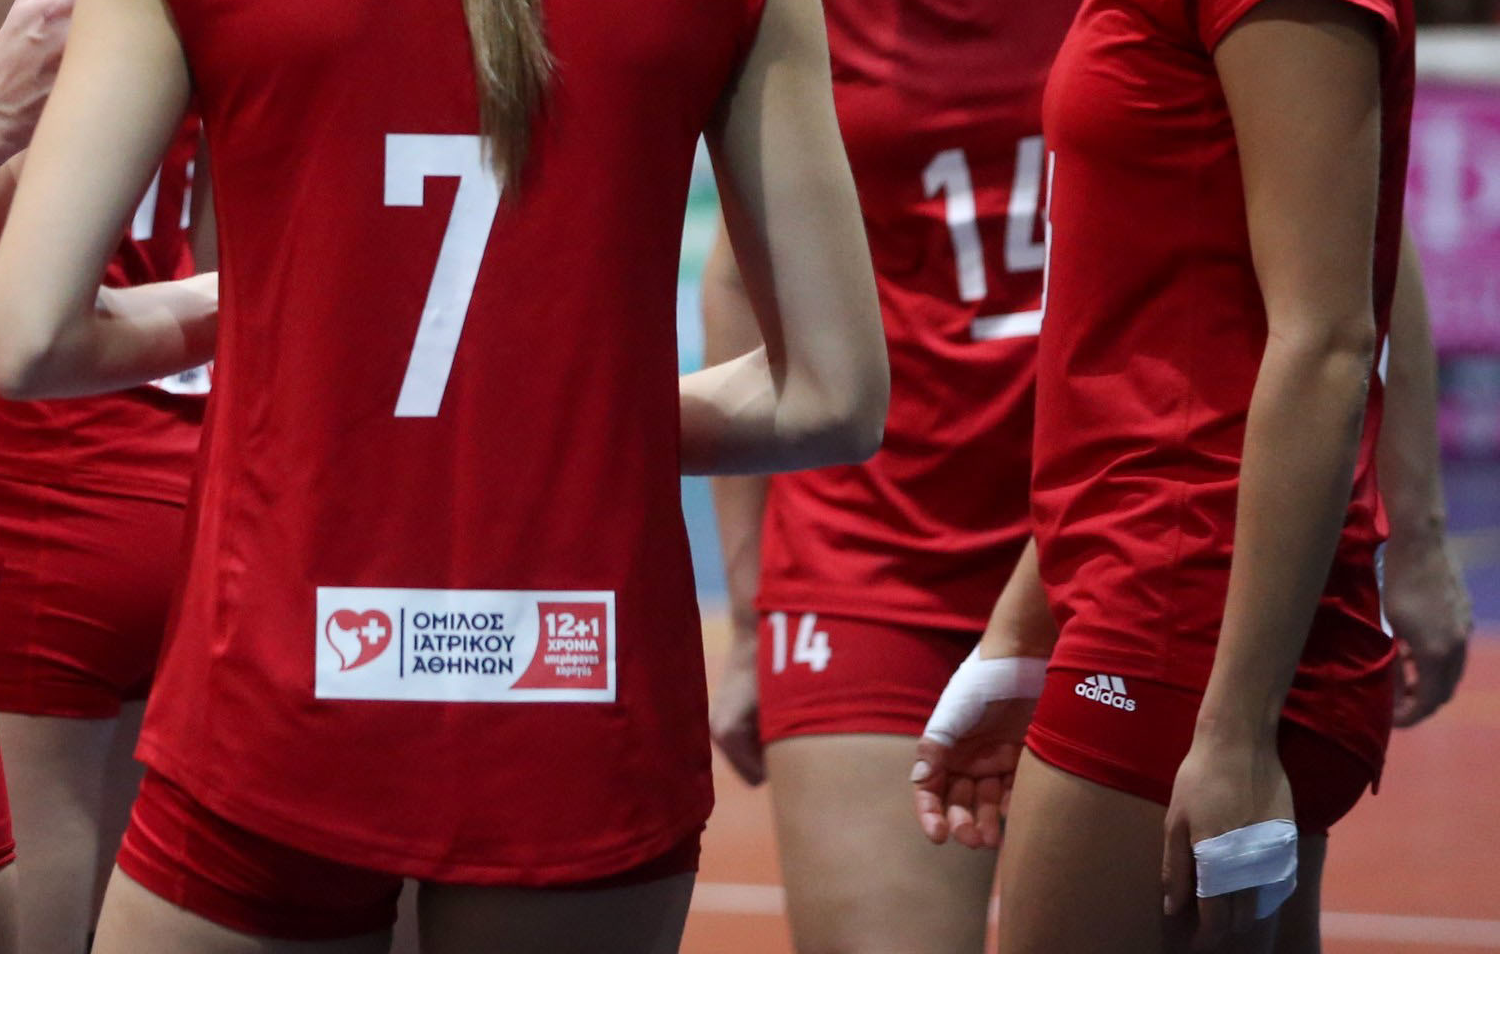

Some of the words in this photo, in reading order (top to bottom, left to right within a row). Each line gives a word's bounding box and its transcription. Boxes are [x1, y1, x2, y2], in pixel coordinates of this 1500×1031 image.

[384, 133, 505, 418] 7
[412, 611, 504, 631] ΟΜΙΛΟΣ
[545, 612, 600, 638] 12+1
[413, 634, 515, 653] ΙΑΤΡΙΚΟΥ
[547, 638, 599, 653] ΧΡΟΝΙΑ
[770, 611, 832, 673] 14
[412, 655, 514, 675] ΑΘΗΝΩΝ
[1075, 683, 1136, 712] adidas
